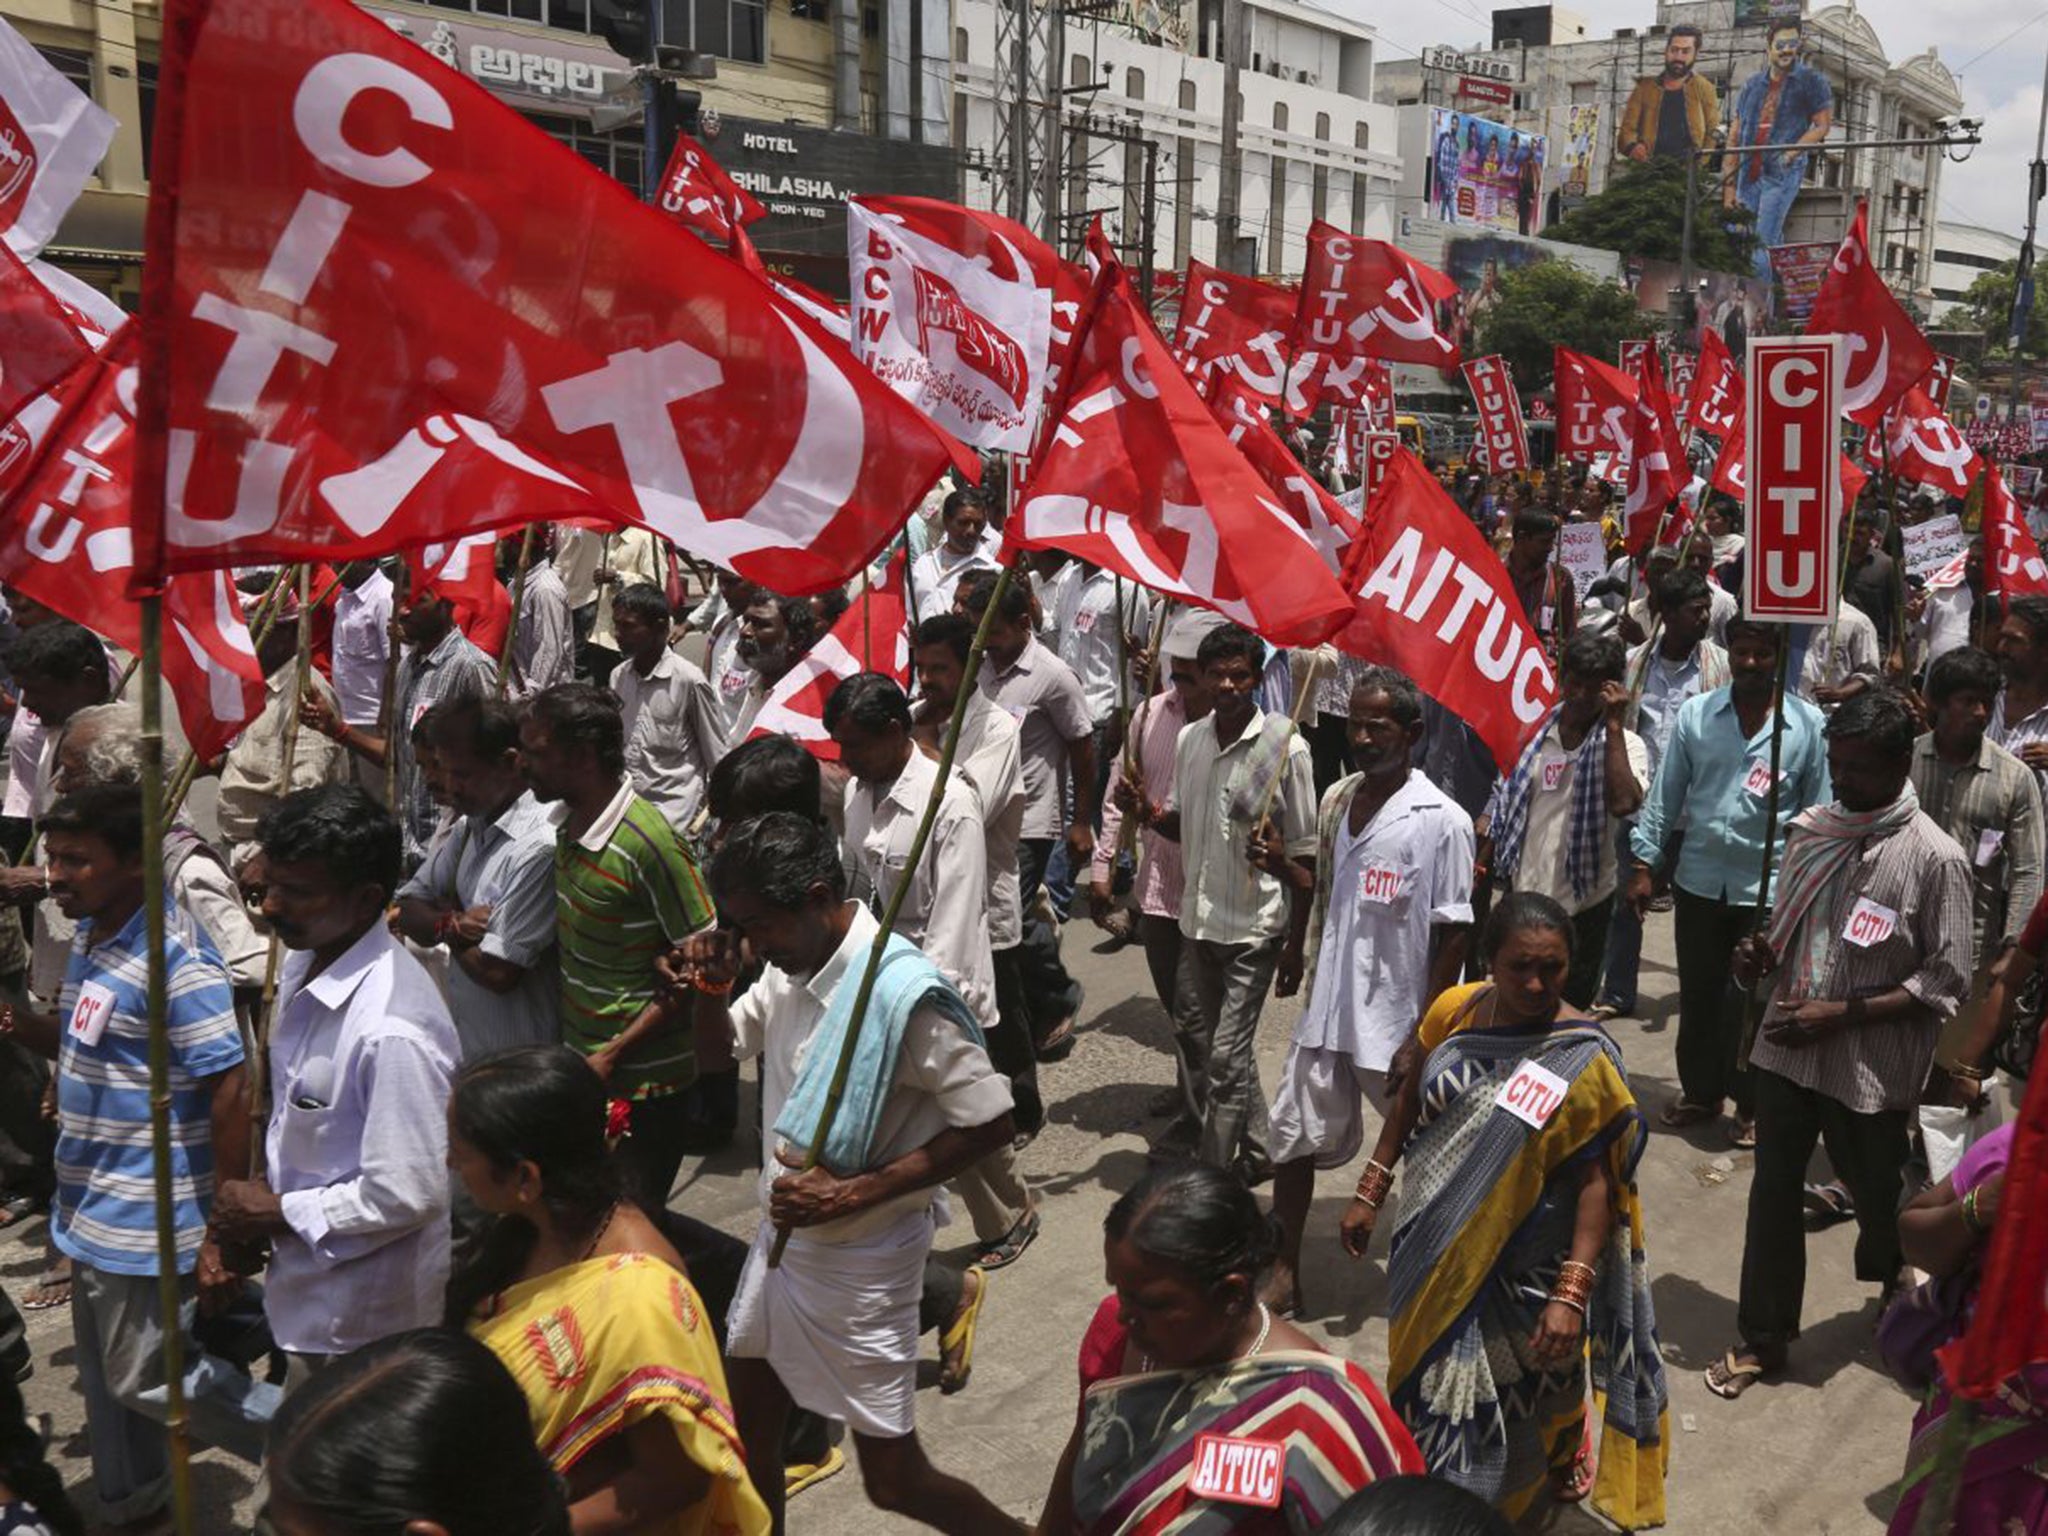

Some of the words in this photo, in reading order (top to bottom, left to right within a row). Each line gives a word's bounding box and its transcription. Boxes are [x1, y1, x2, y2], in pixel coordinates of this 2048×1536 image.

[743, 132, 798, 153] HOTEL
[661, 150, 700, 212] CITU
[767, 263, 794, 276] A/C
[1313, 238, 1353, 344] CITU
[165, 52, 454, 547] CITU
[1765, 357, 1819, 598] CITU
[1358, 526, 1555, 724] AITUC
[1365, 869, 1402, 898] CITU
[1852, 910, 1892, 943] CITU
[74, 996, 100, 1033] CI
[1507, 1074, 1561, 1123] CITU
[1198, 1442, 1278, 1499] AITUC
